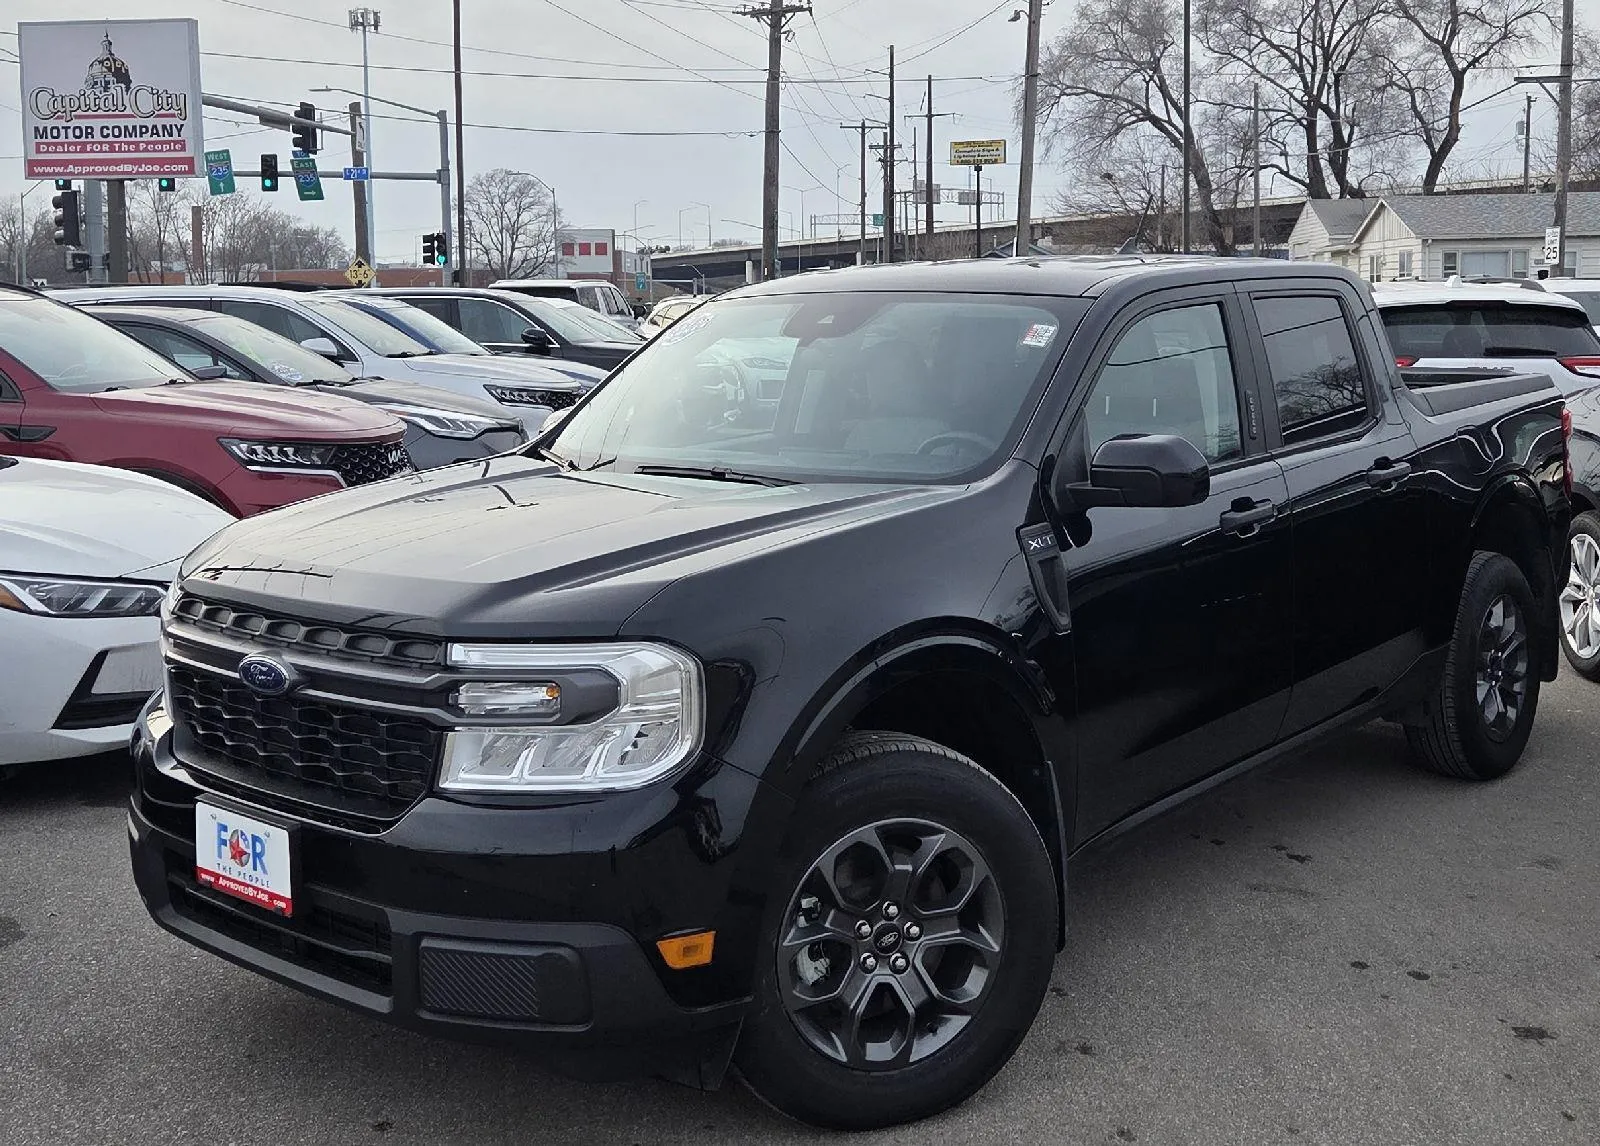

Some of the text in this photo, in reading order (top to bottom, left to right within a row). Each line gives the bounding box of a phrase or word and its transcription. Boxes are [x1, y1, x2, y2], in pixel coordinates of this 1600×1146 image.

[29, 84, 187, 122] Capital City
[33, 123, 185, 140] MOTOR COMPANY
[39, 142, 182, 152] Dealer FOR The People
[33, 163, 189, 174] www.ApprovedByJoe.com
[211, 166, 229, 175] 235
[1545, 247, 1557, 260] 25
[1028, 535, 1052, 550] XLT
[249, 663, 276, 684] Ford
[216, 822, 268, 876] FOR
[216, 862, 270, 888] THE PEOPLE
